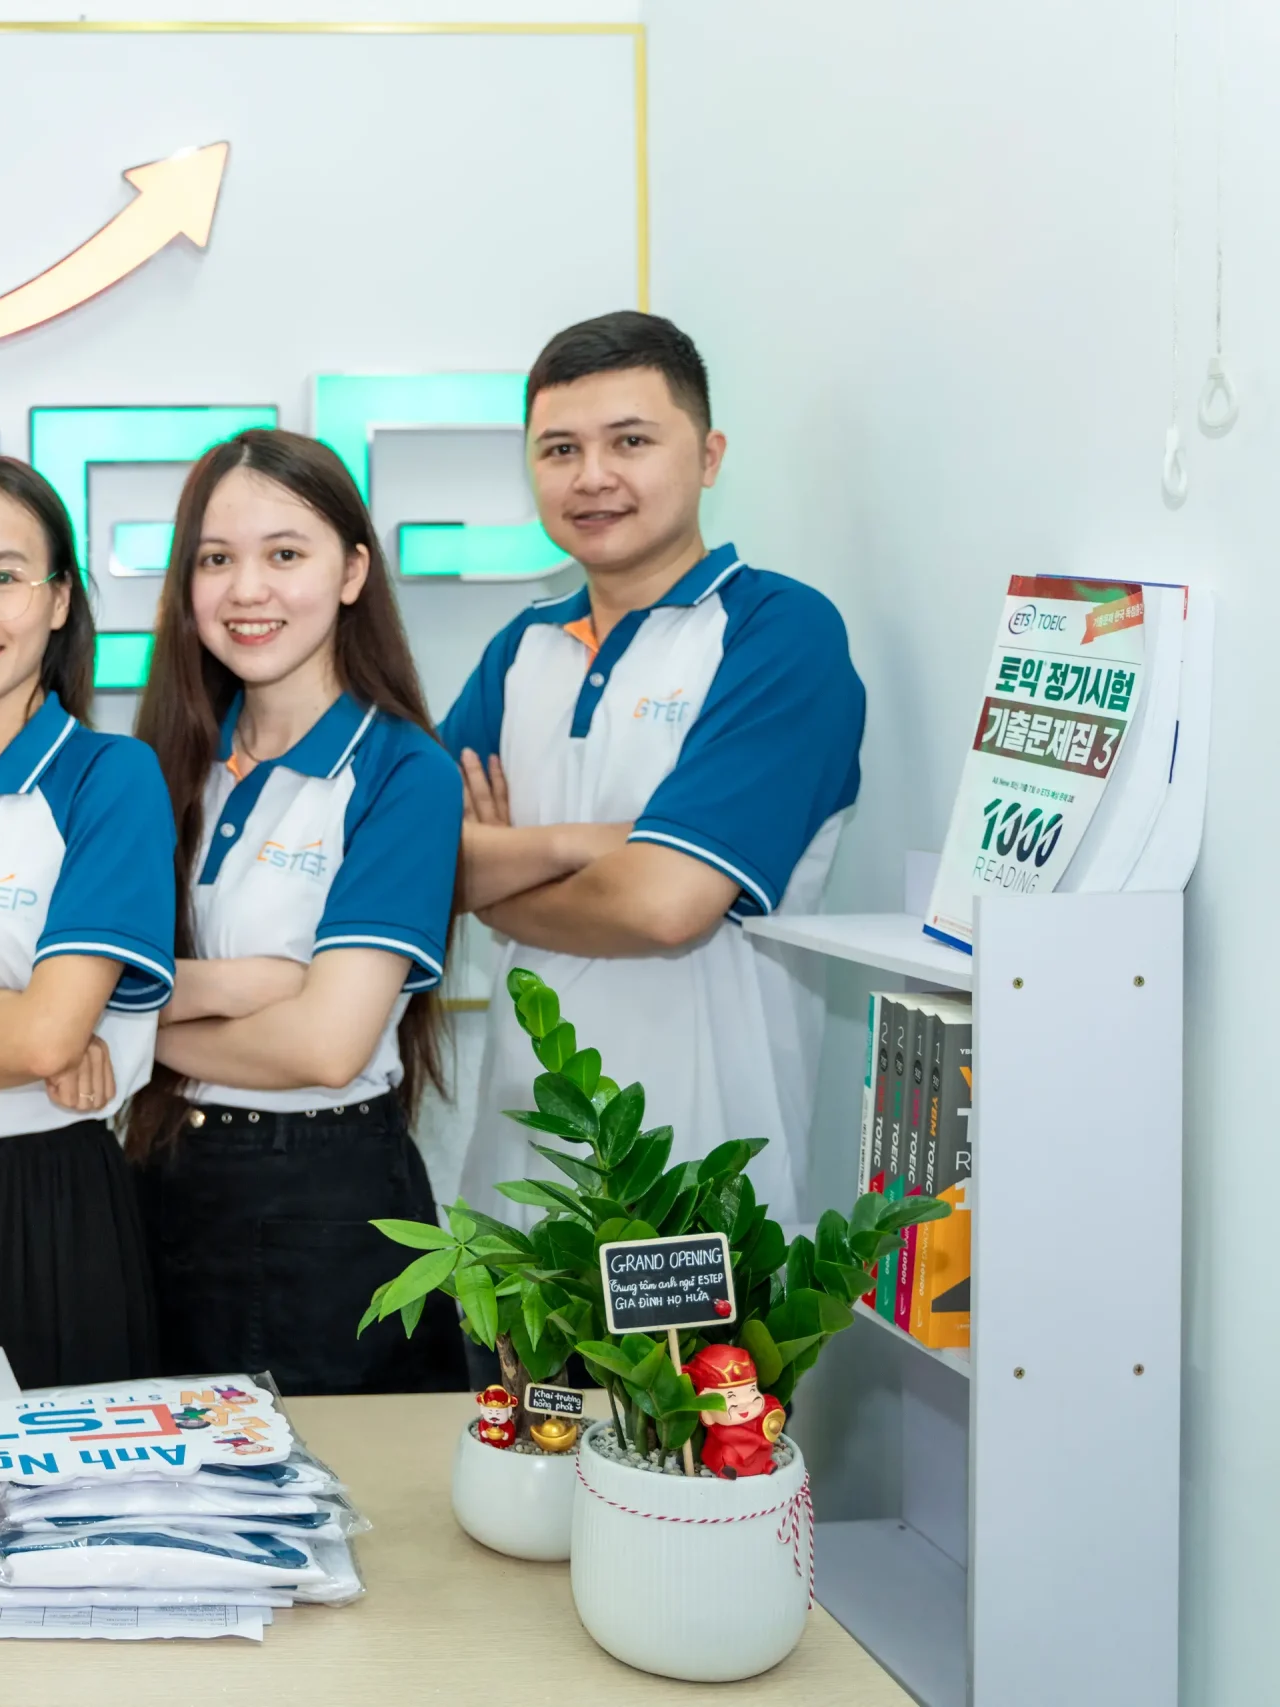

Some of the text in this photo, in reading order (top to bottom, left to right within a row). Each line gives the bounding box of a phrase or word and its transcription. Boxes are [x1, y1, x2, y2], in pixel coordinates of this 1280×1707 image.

[1013, 612, 1067, 631] ETS TOEIC
[995, 656, 1135, 712] 토익 정기시험
[981, 706, 1120, 771] 기출문제집 3
[981, 798, 1063, 868] 1000
[973, 855, 1040, 894] READING
[930, 1097, 938, 1137] YBM
[873, 1116, 883, 1168] TOEIC
[890, 1122, 900, 1175] TOEIC
[908, 1131, 918, 1184] TOEIC
[926, 1141, 936, 1195] TOEIC
[610, 1247, 723, 1274] GRAND OPENING
[608, 1279, 638, 1297] Trung
[639, 1280, 657, 1291] tâm
[658, 1275, 678, 1289] anh
[697, 1272, 724, 1285] ESTEP
[615, 1296, 636, 1311] GIA
[638, 1293, 663, 1308] ĐÌNH
[666, 1295, 682, 1308] HỌ
[15, 1401, 55, 1410] UP
[79, 1394, 163, 1406] STEP
[534, 1388, 554, 1400] Khai
[79, 1443, 187, 1471] Anh
